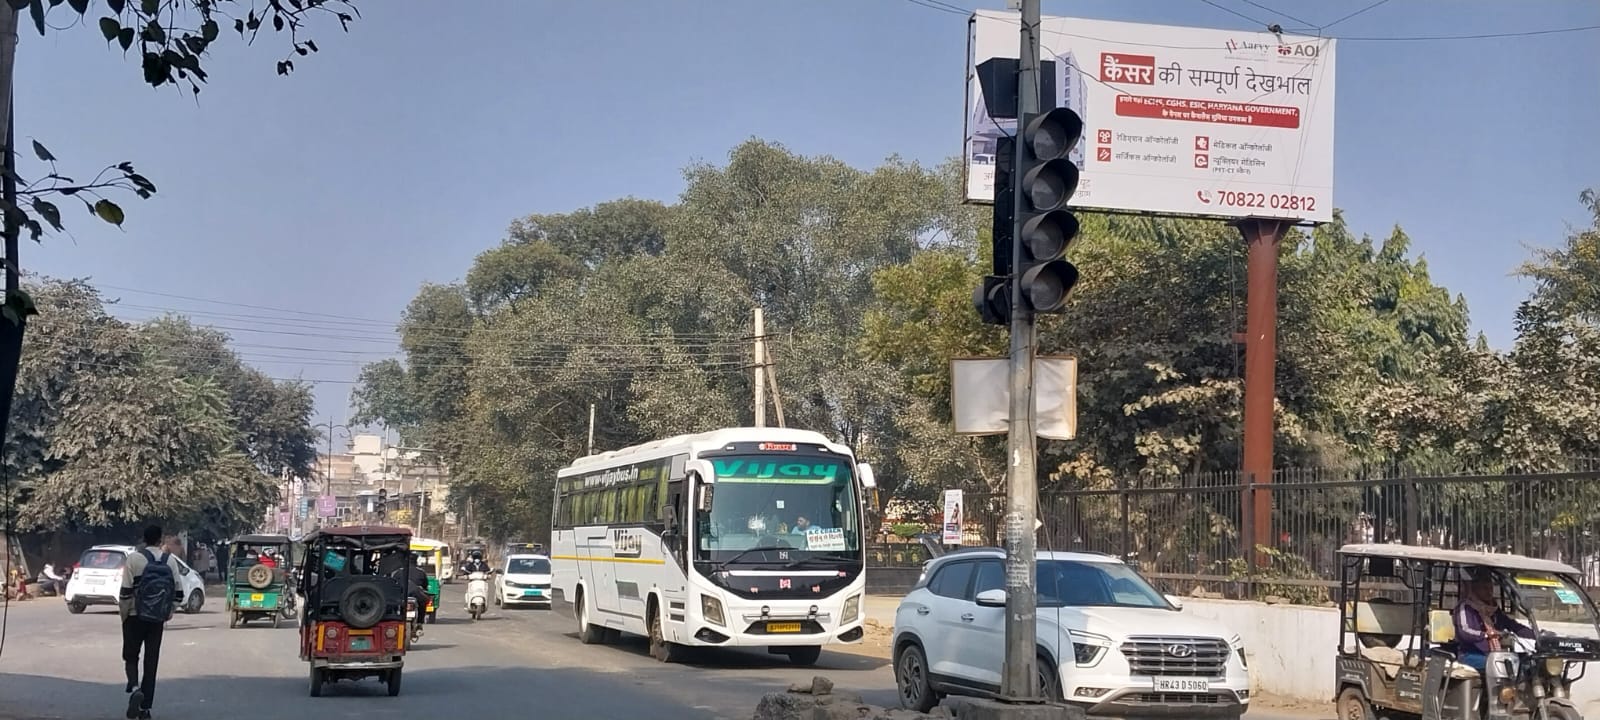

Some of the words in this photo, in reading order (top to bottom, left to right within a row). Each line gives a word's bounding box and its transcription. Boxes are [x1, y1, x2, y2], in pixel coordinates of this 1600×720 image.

[1294, 44, 1319, 57] AOI
[1103, 54, 1153, 84] कैंसर
[1158, 62, 1182, 86] की
[1187, 66, 1240, 94] सम्पूर्ण
[1245, 67, 1312, 95] देखभाल
[1208, 103, 1243, 112] HARYANA
[1217, 190, 1265, 208] 70822
[1270, 194, 1316, 212] 02812
[584, 464, 639, 488] www.vijaybus.in
[713, 459, 838, 482] Vijay
[614, 529, 642, 556] Vijay
[1160, 680, 1180, 690] HR43
[1181, 680, 1187, 690] D
[1188, 680, 1207, 690] 5060
